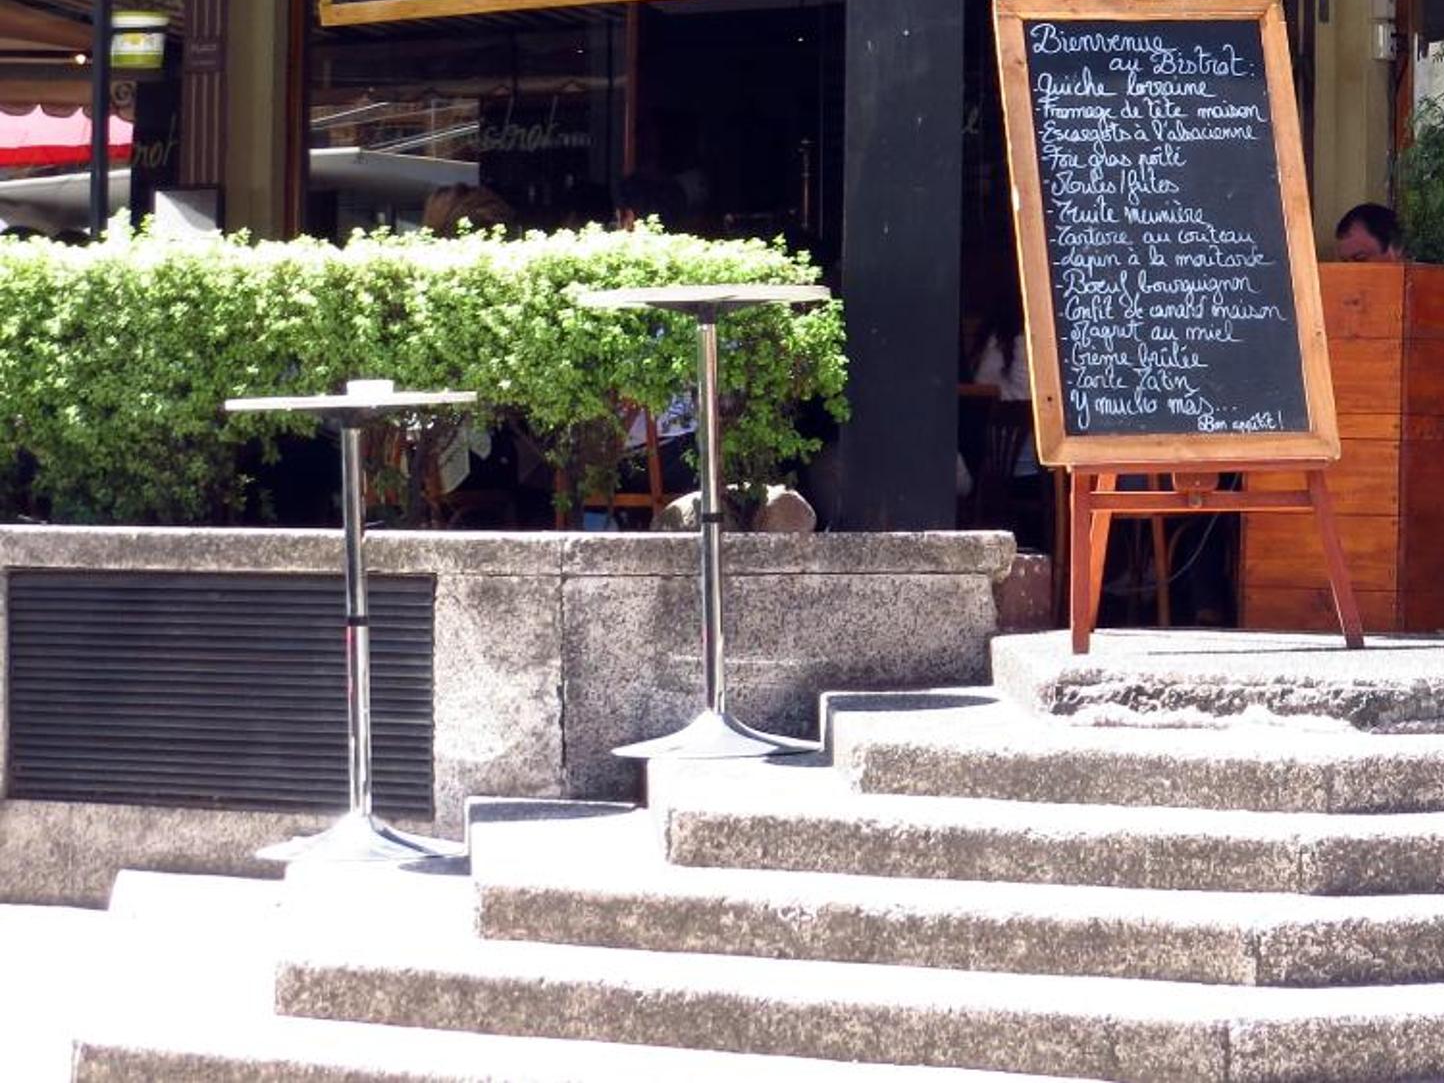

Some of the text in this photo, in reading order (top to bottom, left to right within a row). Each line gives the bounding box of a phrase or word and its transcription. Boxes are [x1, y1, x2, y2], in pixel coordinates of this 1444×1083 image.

[1030, 23, 1177, 54] Bienvenue
[1109, 57, 1144, 72] au
[1120, 98, 1141, 118] de
[1197, 100, 1267, 122] maison
[1143, 231, 1171, 244] au
[1178, 224, 1255, 244] couteau
[1149, 245, 1168, 267] la
[1175, 244, 1276, 267] moutarde
[1211, 299, 1287, 320] maison
[1151, 325, 1179, 340] au
[1186, 319, 1244, 342] miel
[1095, 389, 1157, 415] mucho
[1198, 414, 1227, 431] Bon
